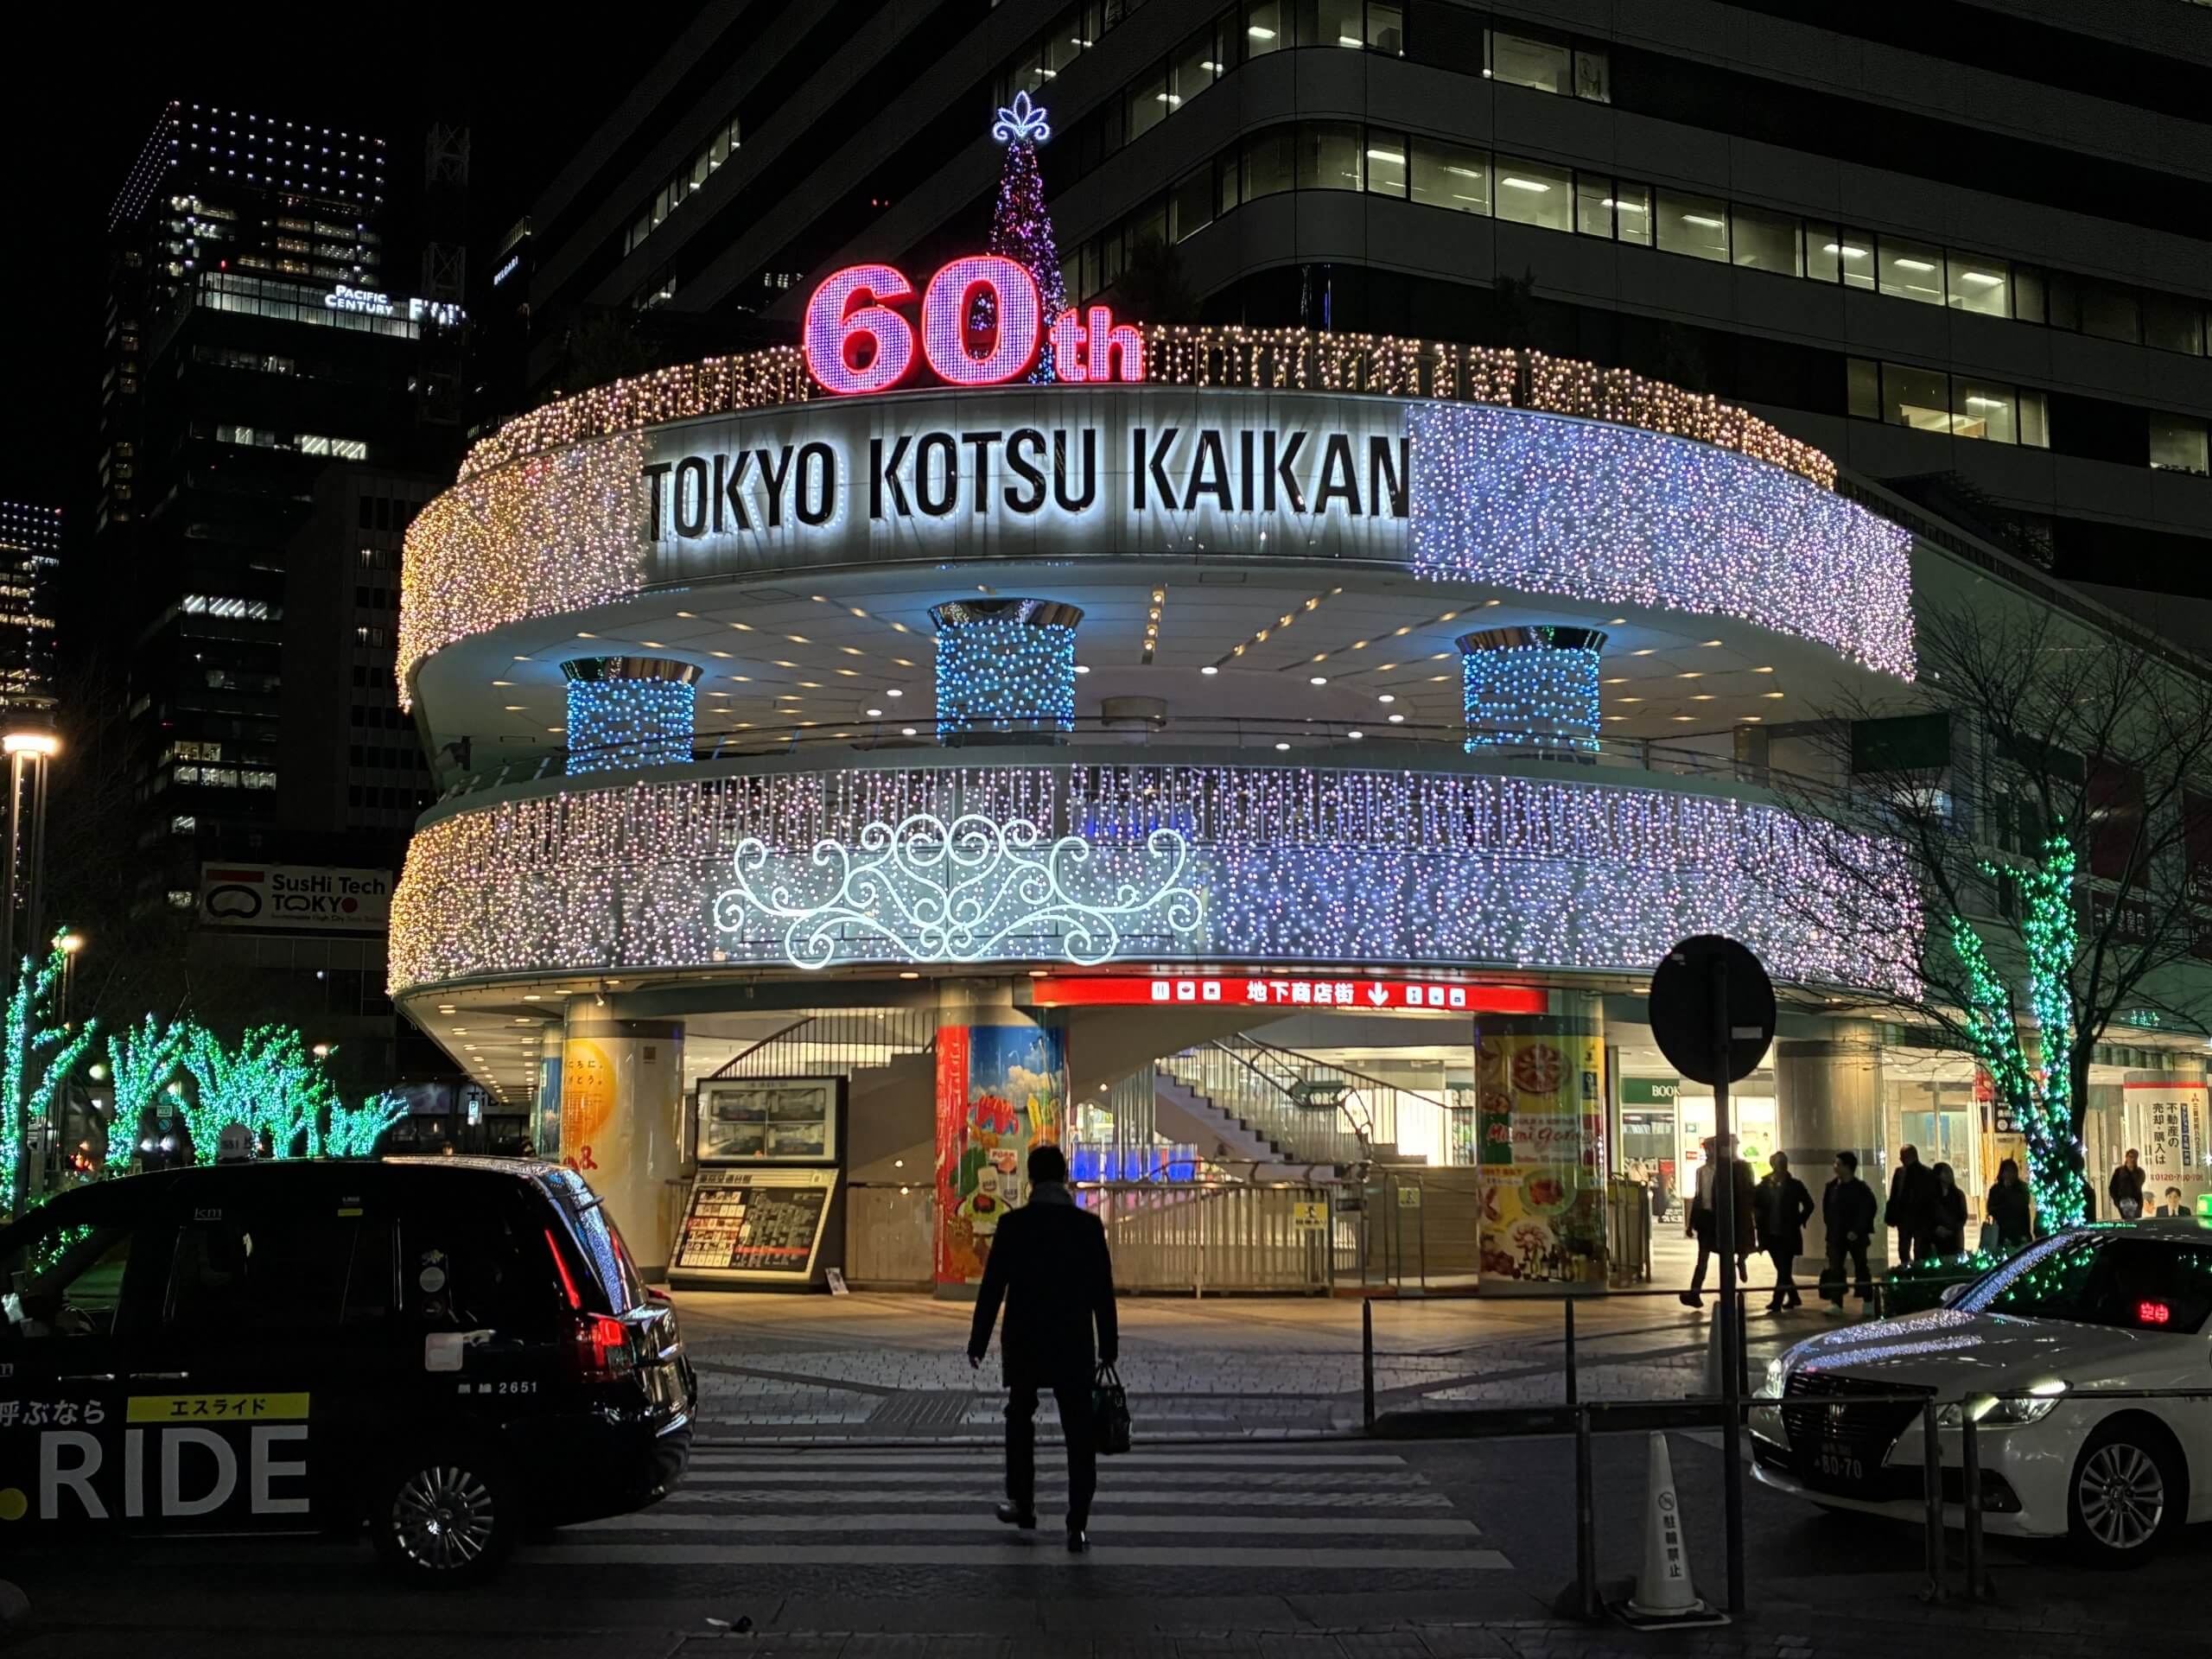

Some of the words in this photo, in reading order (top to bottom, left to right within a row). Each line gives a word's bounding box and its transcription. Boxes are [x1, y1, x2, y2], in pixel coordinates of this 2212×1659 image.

[335, 284, 387, 303] PACIFIC
[325, 295, 393, 315] CENTURY
[805, 255, 1143, 394] 60th
[643, 442, 836, 542] TOKYO
[869, 428, 1096, 519] KOTSU
[1133, 428, 1411, 518] KAIKAN
[272, 874, 332, 893] SusHi
[338, 876, 385, 894] Tech
[1247, 981, 1354, 1003] 地下商店街
[2152, 1103, 2166, 1166] 売却・購入は
[2166, 1103, 2179, 1147] 不動産の
[194, 1206, 222, 1220] km
[499, 1381, 537, 1395] 2651
[170, 1397, 267, 1416] エスライド
